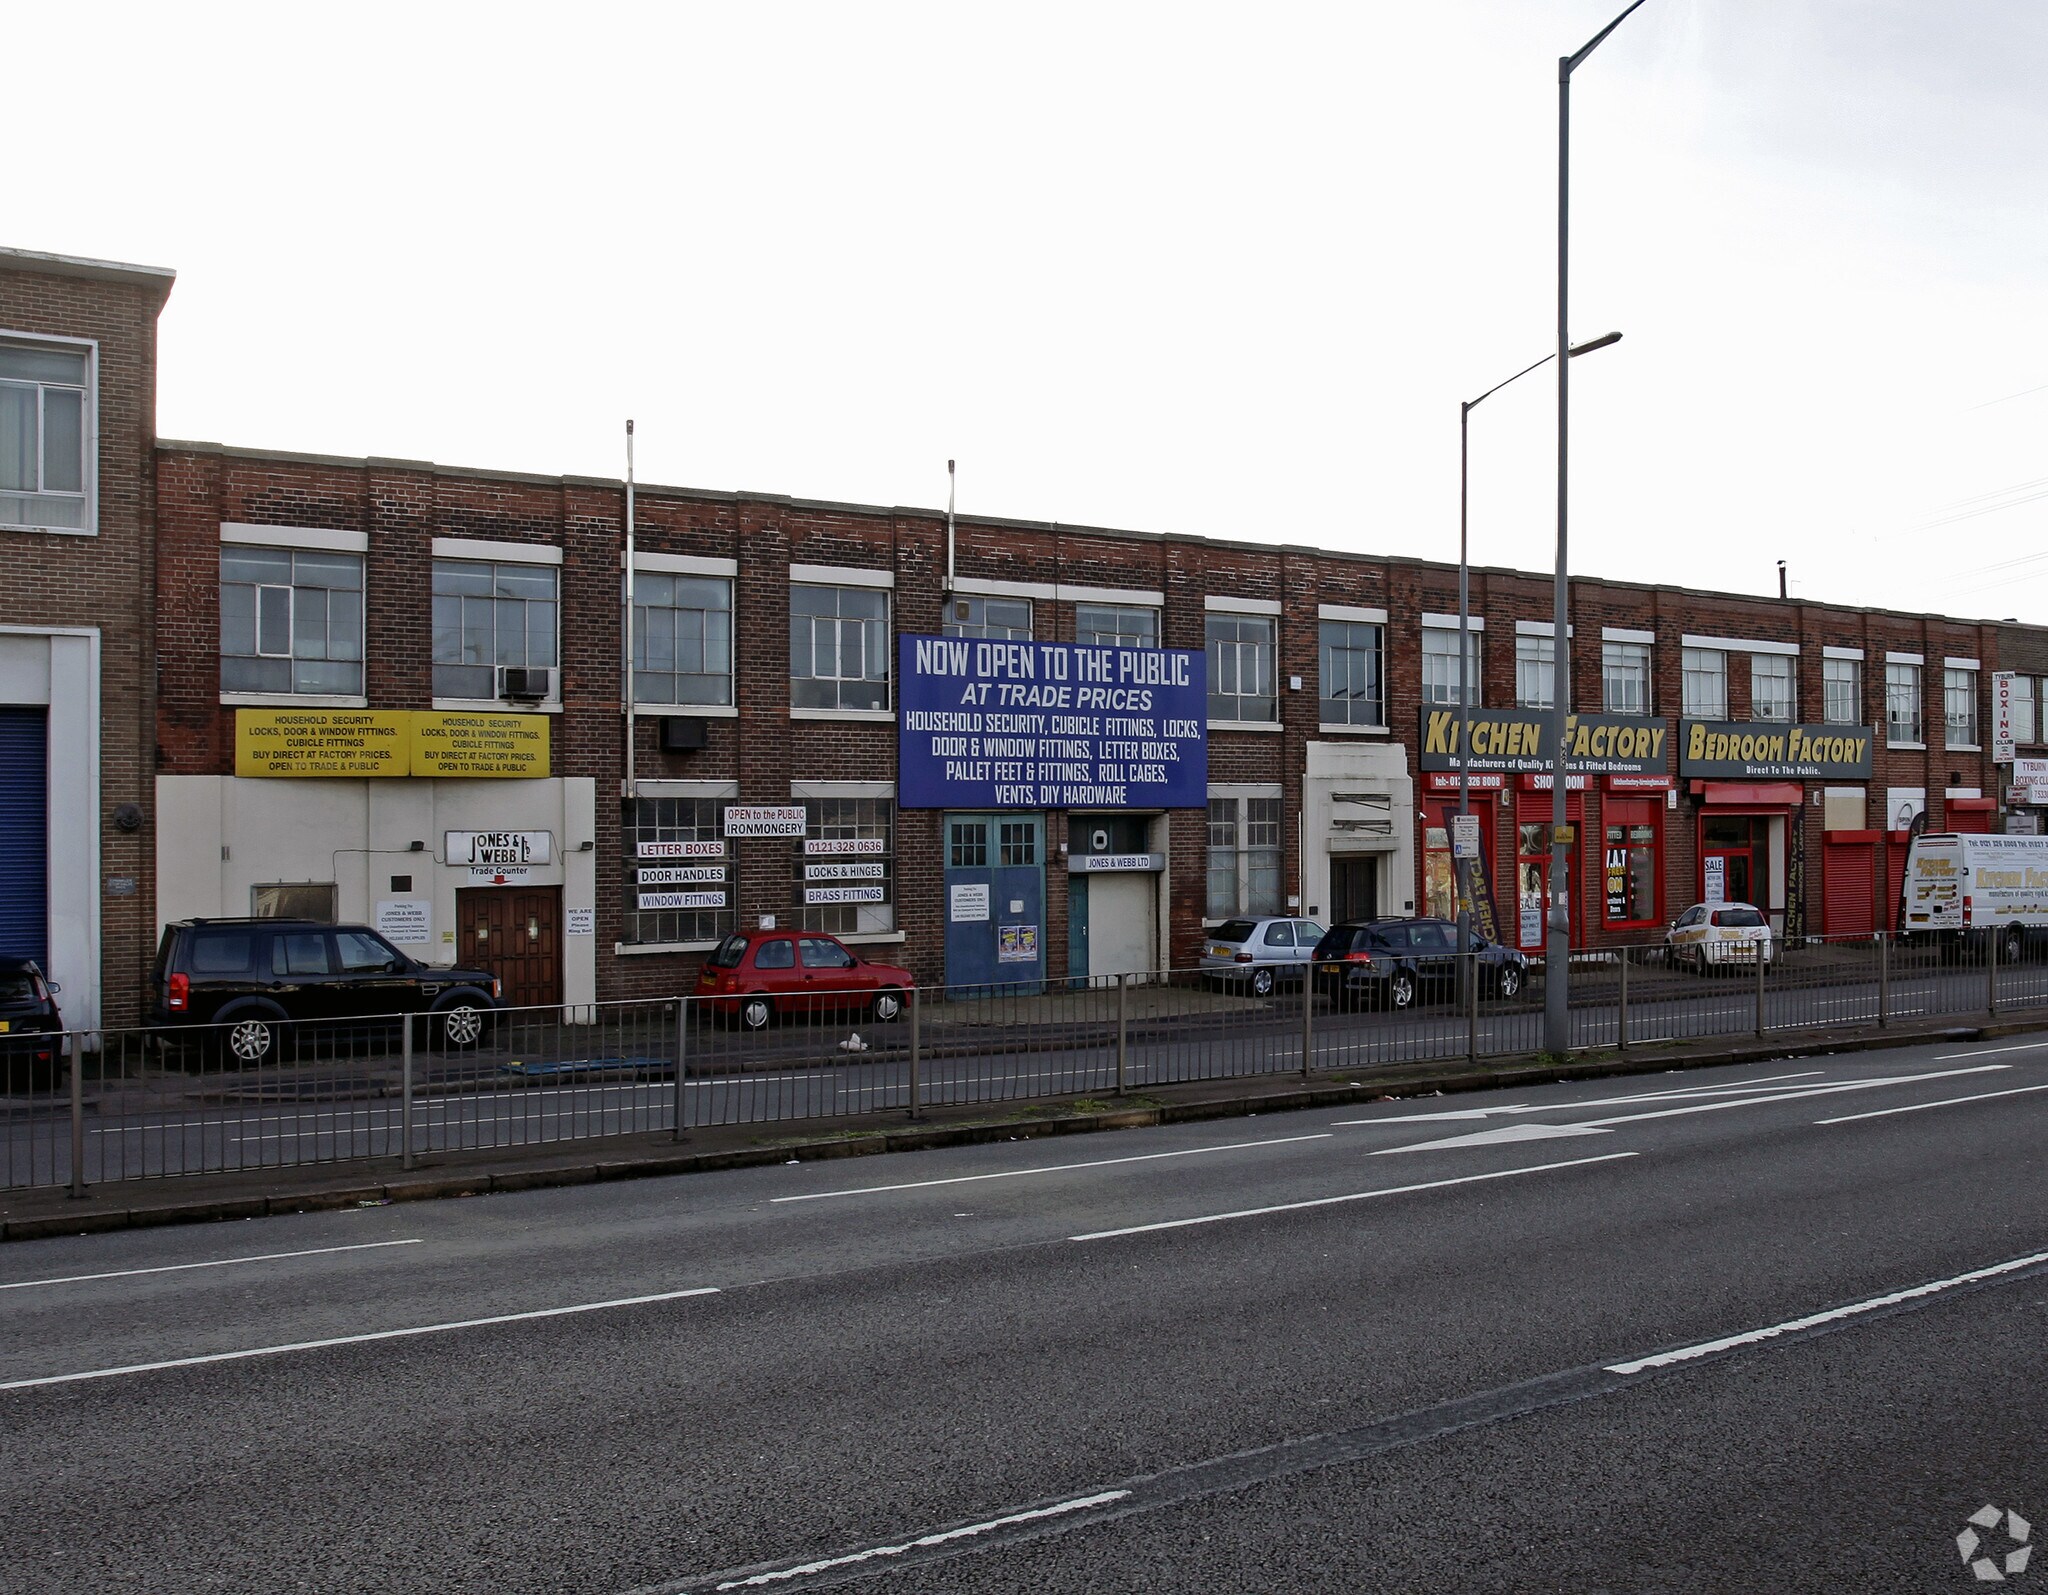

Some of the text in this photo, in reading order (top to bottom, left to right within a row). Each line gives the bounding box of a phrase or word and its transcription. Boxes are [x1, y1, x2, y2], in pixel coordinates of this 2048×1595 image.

[916, 640, 1189, 686] NOW OPEN TO THE PUBLIC
[960, 683, 1153, 711] AT TRADE PRICES
[2000, 680, 2009, 739] BOXING
[443, 718, 522, 728] HOUSEHOLD SECURITY
[906, 711, 1201, 740] HOUSEHOLD SECURITY, CUBICLE FITTINGS, LOCKS,
[249, 728, 397, 736] LOCKS, DOOR & WINDOW FITTINGS.
[421, 729, 447, 738] LOCKS,
[450, 729, 469, 737] DOOR
[479, 730, 507, 738] WINDOW
[509, 731, 540, 740] FITTINGS.
[286, 739, 364, 747] CUBICLE FITTINGS
[452, 740, 515, 749] CUBICLE FITTINGS
[1688, 724, 1866, 763] BEDROOM FACTORY
[253, 751, 392, 759] BUY DIRECT AT FACTORY PRICES.
[932, 737, 1180, 762] DOOR & WINDOW FITTINGS, LETTER BOXES,
[425, 751, 439, 759] BUY
[479, 752, 509, 760] FACTORY
[511, 753, 536, 761] PRICES.
[269, 762, 379, 770] OPEN TO TRADE & PUBLIC
[472, 763, 493, 771] TRADE
[496, 763, 501, 771] &
[502, 764, 526, 772] PUBLIC
[1508, 759, 1516, 768] of
[1517, 759, 1544, 771] Quality
[1579, 761, 1584, 769] &
[1586, 761, 1606, 770] Fitted
[1608, 762, 1642, 771] Bedrooms
[1746, 765, 1769, 774] Direct
[1771, 766, 1780, 774] To
[1782, 766, 1794, 774] The
[2022, 762, 2046, 771] TYBURN
[946, 761, 1168, 784] PALLET FEET & FITTINGS, ROLL CAGES,
[1468, 776, 1480, 786] 326
[1482, 776, 1500, 786] 8008
[1534, 775, 1584, 789] SHOOOM
[2015, 776, 2038, 785] BOXING
[995, 785, 1127, 805] VENTS, DIY HARDWARE
[728, 809, 805, 820] OPEN to the PUBLIC
[727, 823, 803, 835] IRONMONGERY
[468, 833, 519, 863] JONES &
[641, 843, 722, 855] LETTER BOXES
[808, 842, 881, 853] 0121-328 0636
[481, 849, 516, 863] WEBB
[1088, 857, 1148, 868] JONES & WEBB LTD
[1706, 860, 1722, 871] SALE
[470, 867, 527, 875] Trade Counter
[642, 869, 723, 882] DOOR HANDLES
[808, 866, 882, 878] LOCKS & HINGES
[1607, 877, 1623, 893] ON
[642, 894, 723, 907] WINDOW FITTINGS
[808, 889, 881, 902] BRASS FITTINGS
